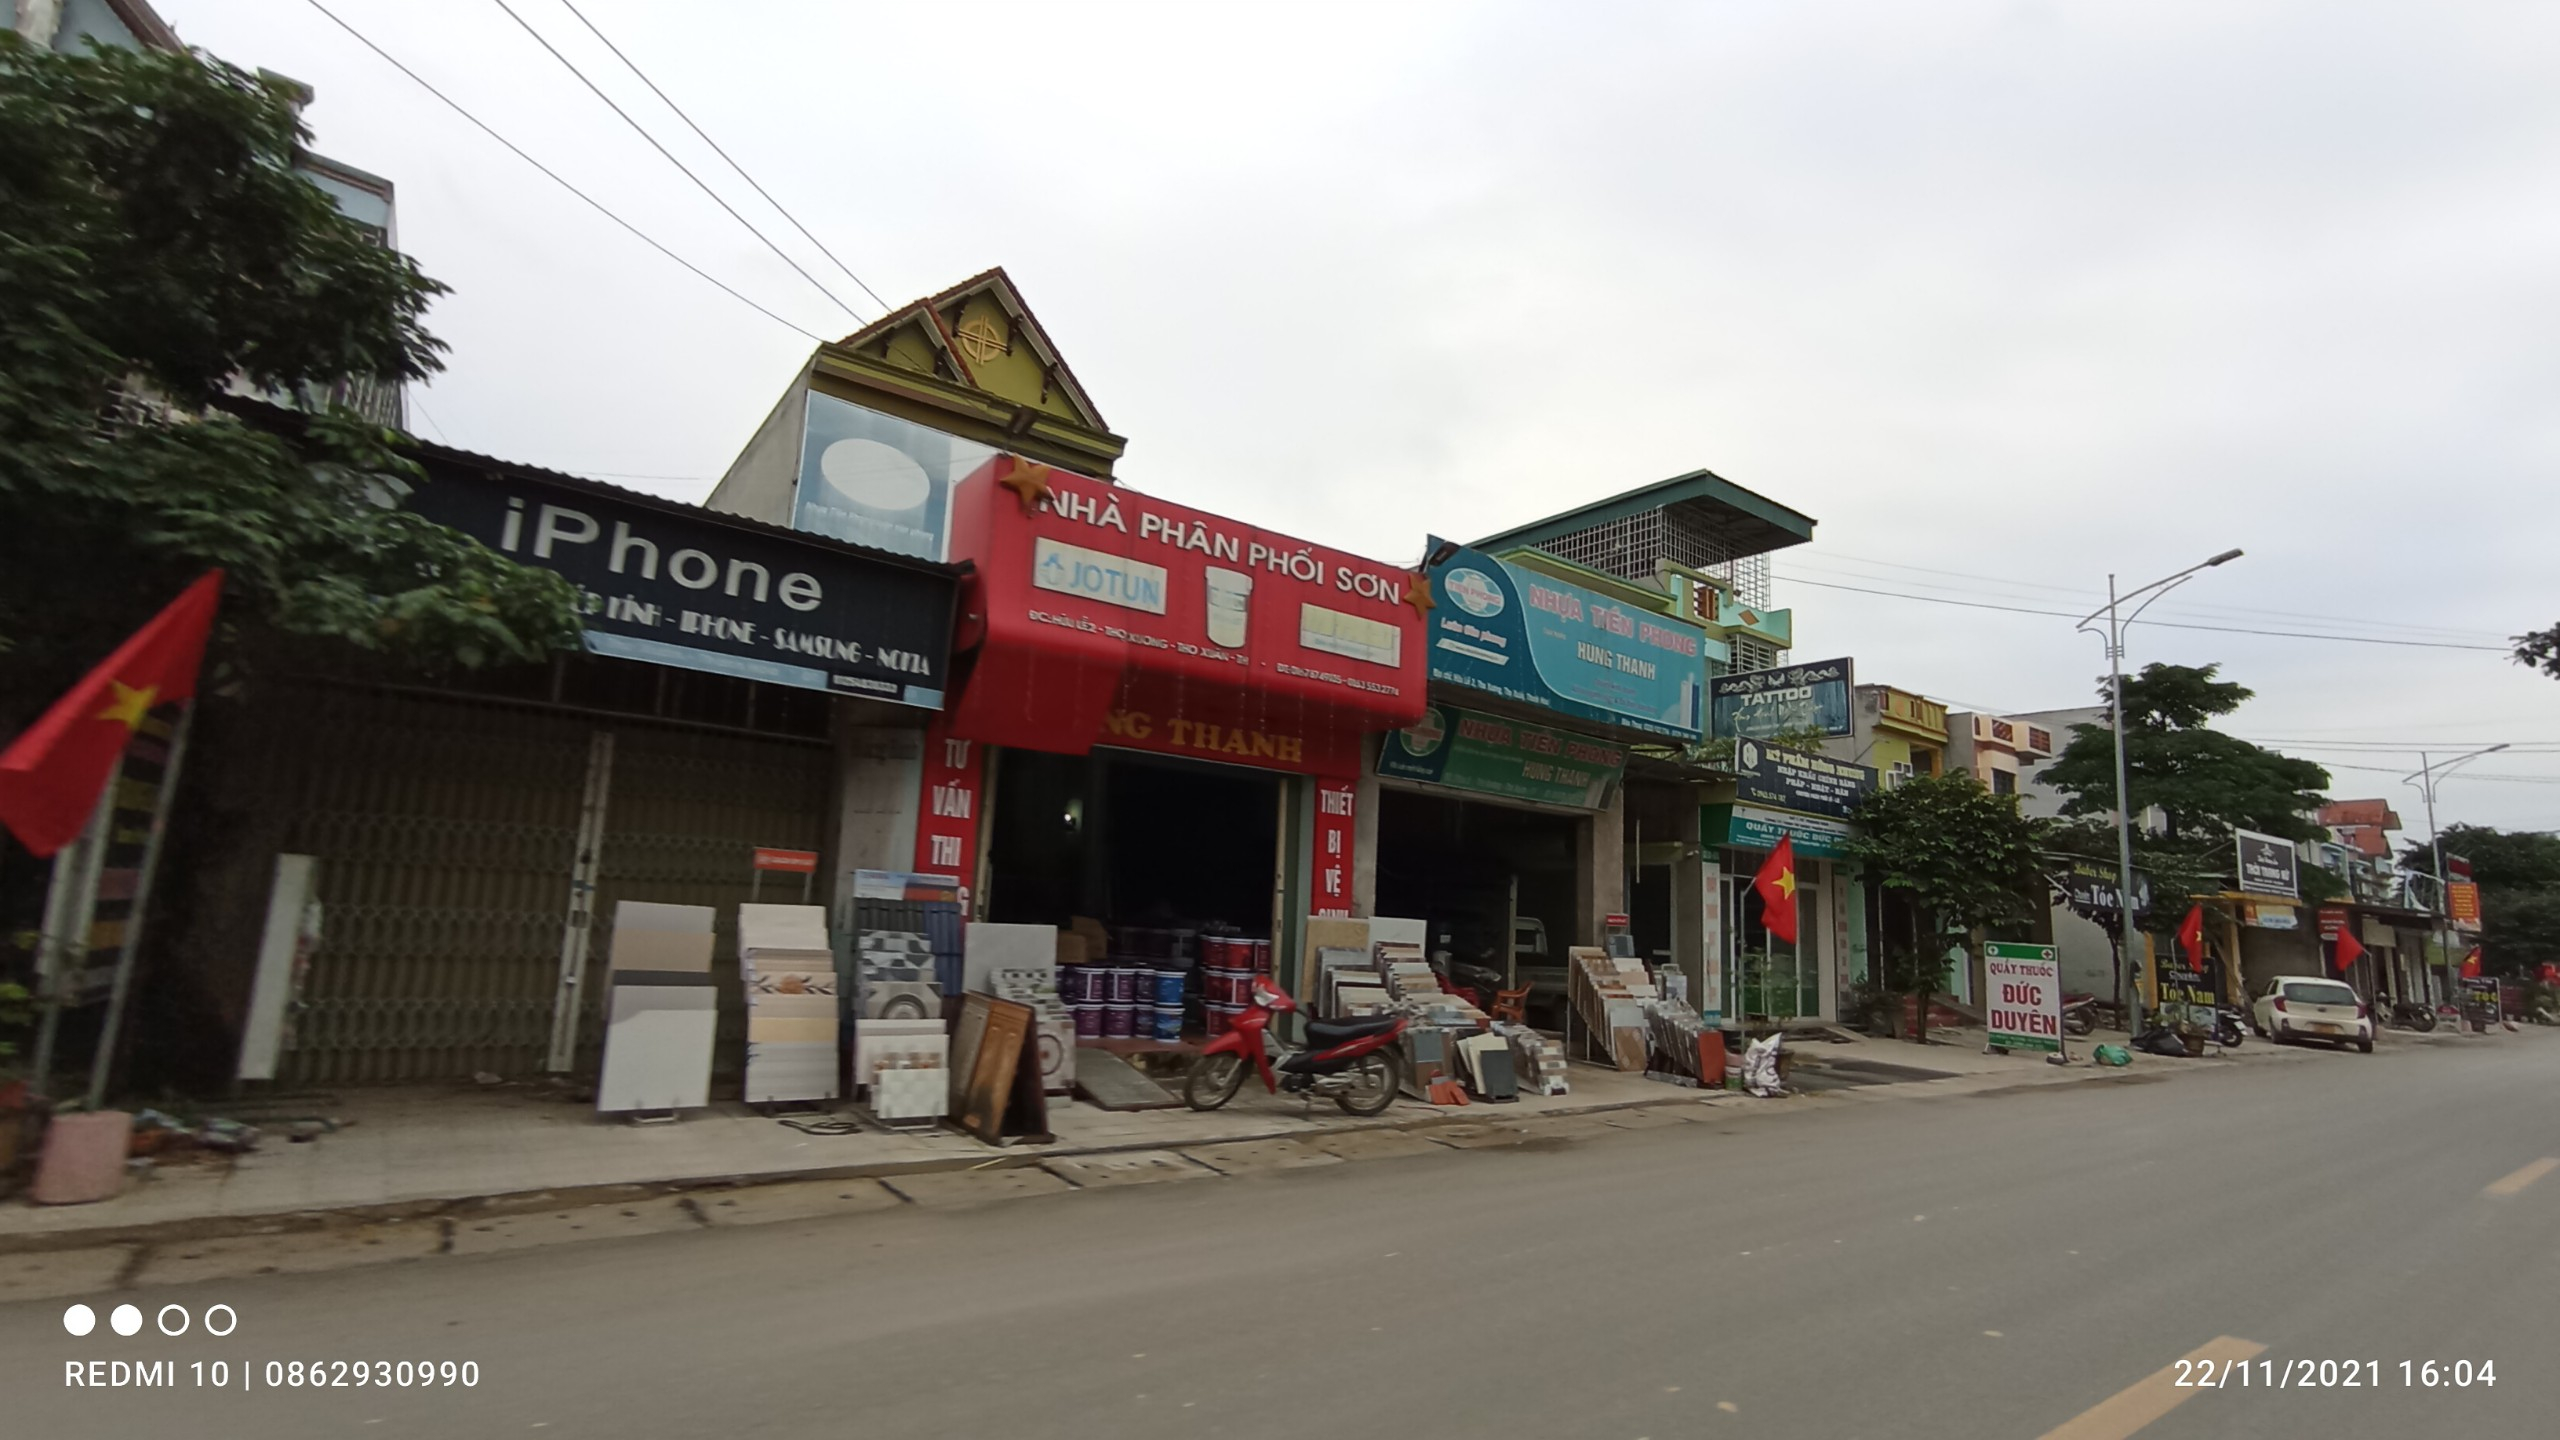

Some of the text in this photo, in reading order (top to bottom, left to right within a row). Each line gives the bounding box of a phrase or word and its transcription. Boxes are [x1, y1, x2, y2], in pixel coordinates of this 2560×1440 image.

[501, 496, 823, 612] iPhone
[1039, 486, 1401, 606] NHÀ PHÂN PHỐI SƠN
[1070, 561, 1161, 607] JOTUN
[773, 627, 862, 664] SAMSUNG
[1639, 621, 1698, 657] PHONG
[1615, 653, 1657, 681] THANH
[1740, 685, 1813, 707] TATTOO
[1167, 718, 1302, 763] THANH
[1566, 740, 1623, 768] PHONG
[1555, 766, 1592, 789] THANH
[931, 834, 962, 867] THI
[2002, 980, 2042, 1006] ĐỨC
[1991, 1008, 2057, 1036] DUYÊN
